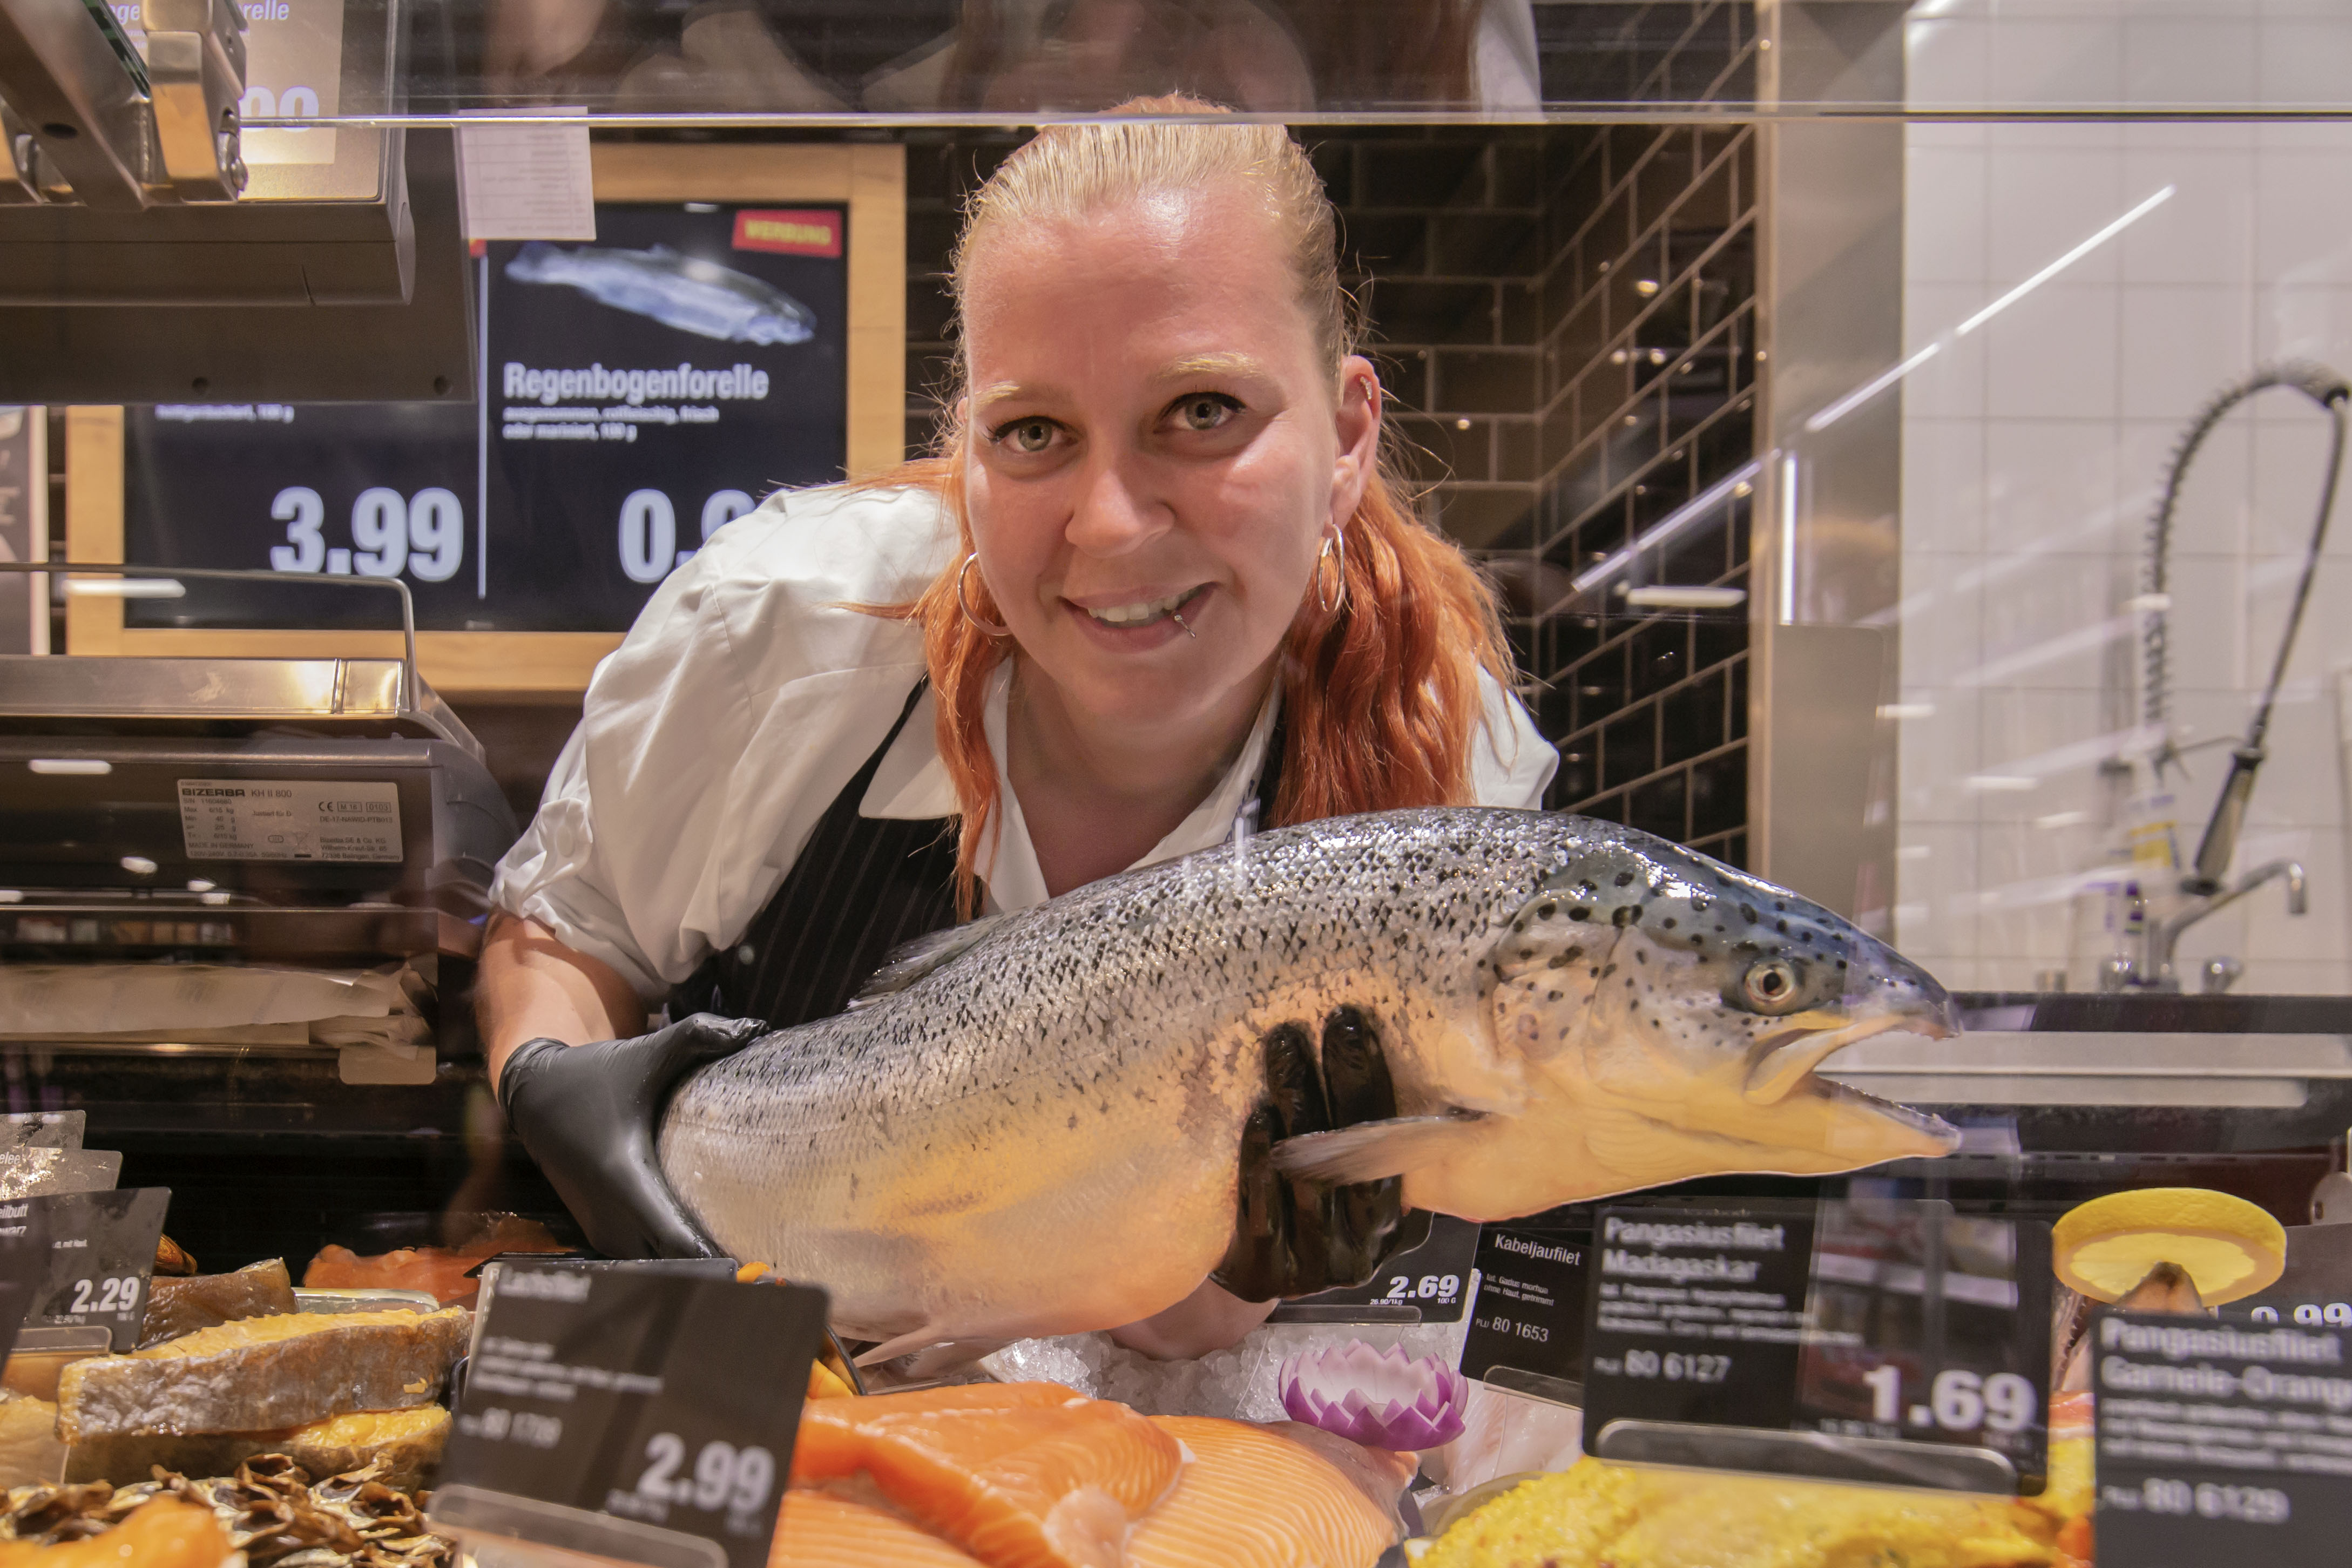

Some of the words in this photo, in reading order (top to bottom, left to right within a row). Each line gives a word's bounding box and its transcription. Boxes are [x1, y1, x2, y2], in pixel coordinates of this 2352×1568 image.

[504, 362, 769, 405] Regenbogenforelle
[271, 486, 463, 582] 3.99
[182, 788, 245, 797] BIZERBA
[276, 789, 292, 797] 800
[0, 1152, 21, 1165] elee
[0, 1204, 29, 1218] eilbutt
[1495, 1233, 1581, 1266] Kabeljaufilet
[1604, 1216, 1786, 1252] Pangasiusfilet
[1601, 1247, 1761, 1283] Madagaskar
[71, 1277, 140, 1313] 2.29
[1387, 1274, 1459, 1299] 2.69
[1484, 1284, 1501, 1294] ohne
[1499, 1275, 1520, 1288] Gadus
[1522, 1282, 1549, 1295] morhua
[1476, 1317, 1490, 1328] PLU
[1492, 1316, 1511, 1333] 80
[1515, 1321, 1550, 1343] 1653
[1663, 1351, 1732, 1383] 6127
[1862, 1364, 2038, 1432] 1.69
[636, 1432, 775, 1511] 2.99
